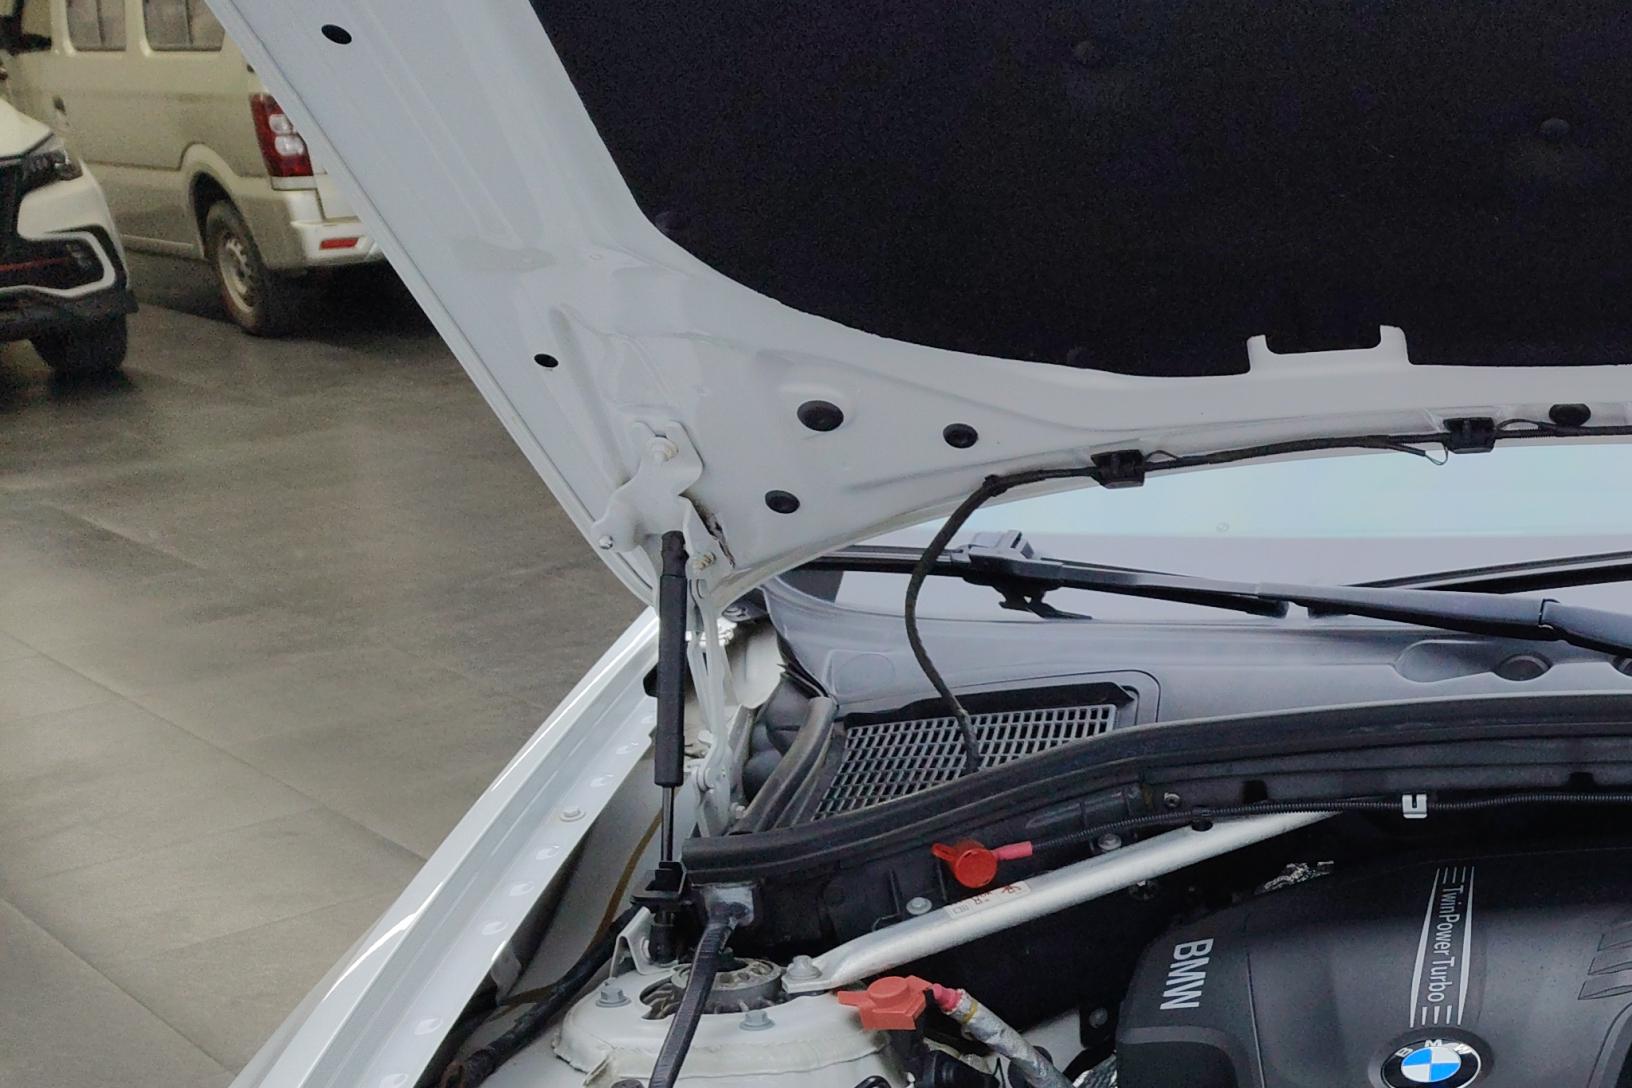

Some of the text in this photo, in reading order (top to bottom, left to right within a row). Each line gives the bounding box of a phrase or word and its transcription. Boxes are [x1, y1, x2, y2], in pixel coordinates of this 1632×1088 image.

[1160, 938, 1214, 1010] BMW
[1427, 884, 1464, 1003] TwinPower Turbo
[1394, 1039, 1473, 1058] BMW
